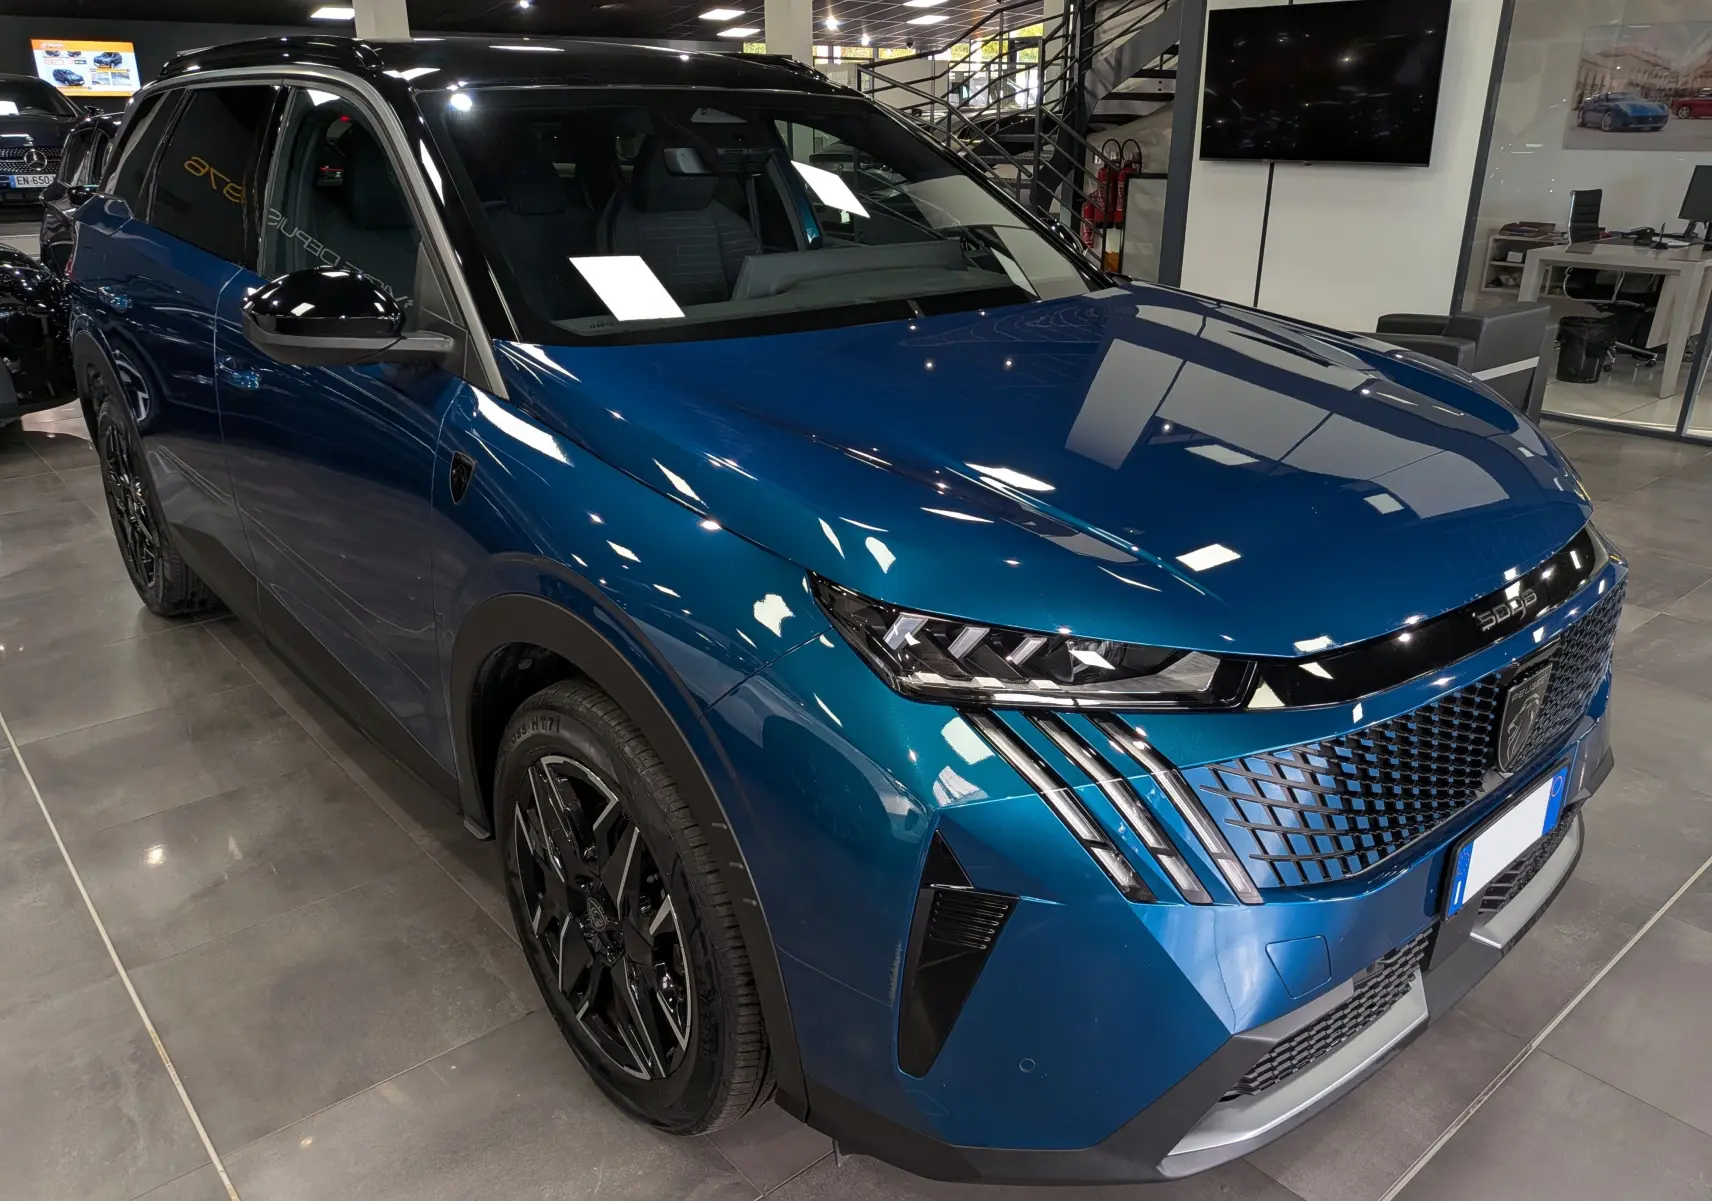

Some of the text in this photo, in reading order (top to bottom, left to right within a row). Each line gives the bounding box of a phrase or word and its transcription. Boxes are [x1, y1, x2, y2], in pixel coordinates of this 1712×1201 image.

[16, 175, 54, 185] EN-650-
[1477, 588, 1537, 631] 5008
[1511, 673, 1549, 702] PEUGEOT
